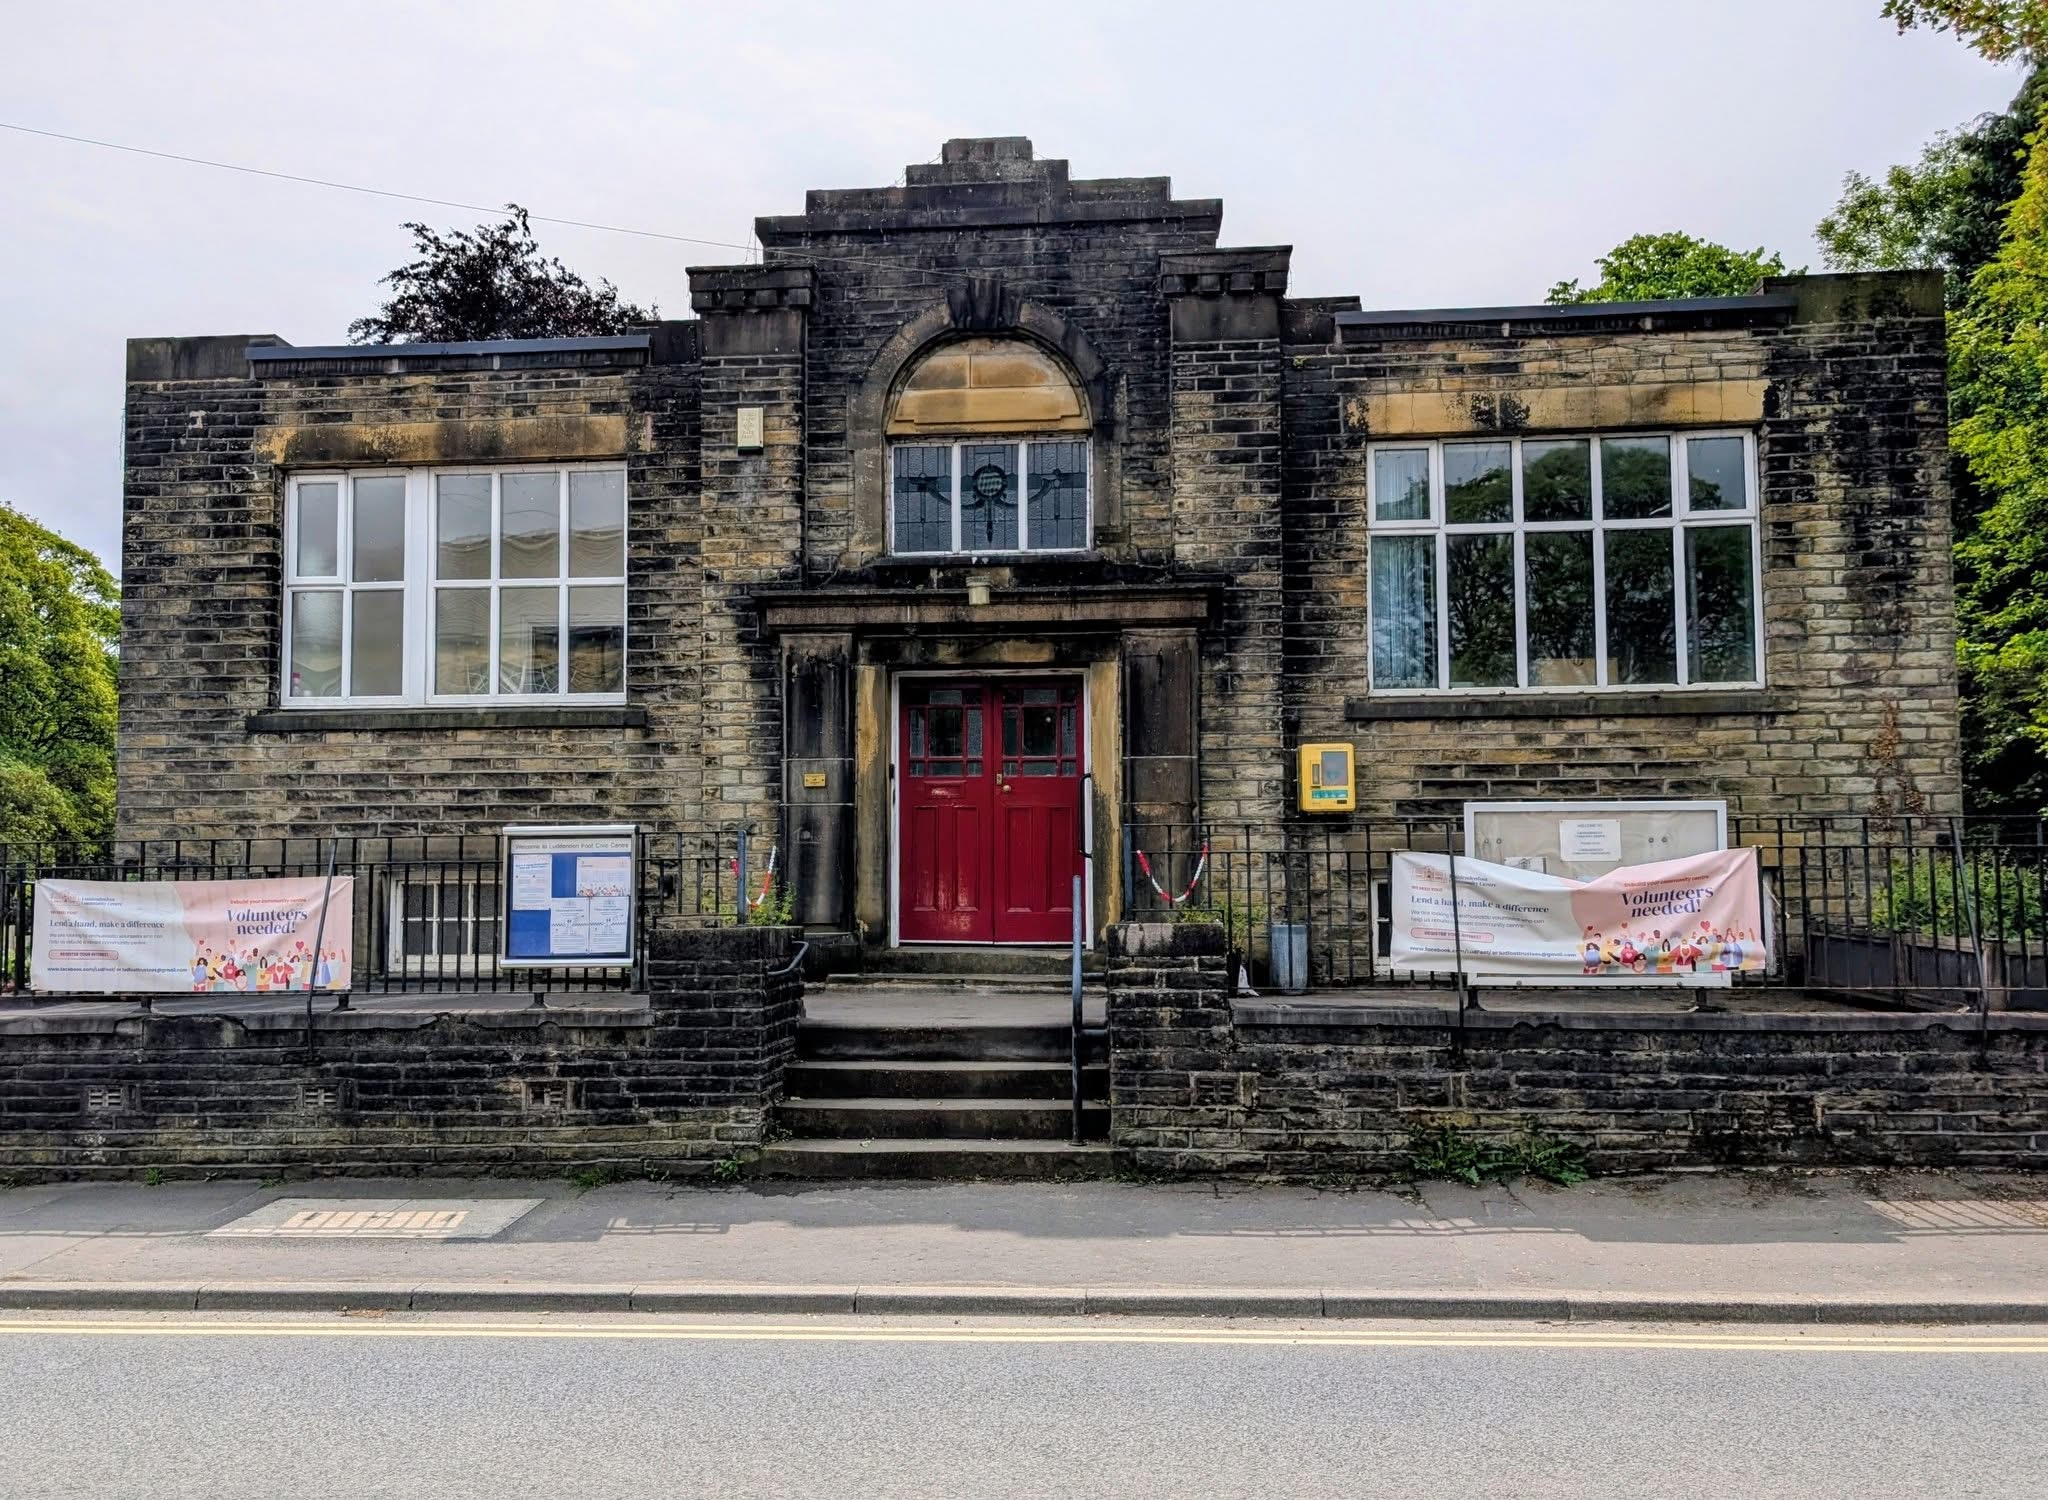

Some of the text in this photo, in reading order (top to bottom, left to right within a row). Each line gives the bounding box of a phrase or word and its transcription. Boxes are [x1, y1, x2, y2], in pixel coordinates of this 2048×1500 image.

[1411, 895, 1433, 904] Lend
[1441, 898, 1466, 908] had,
[1468, 900, 1494, 909] make
[1502, 903, 1550, 913] difference
[1621, 887, 1714, 906] Volunteers
[227, 909, 308, 922] Volunteers
[1632, 899, 1702, 917] needed!
[50, 919, 68, 927] Lend
[74, 919, 97, 928] hand,
[99, 919, 119, 928] make
[126, 919, 165, 928] difference
[237, 921, 296, 935] needed!
